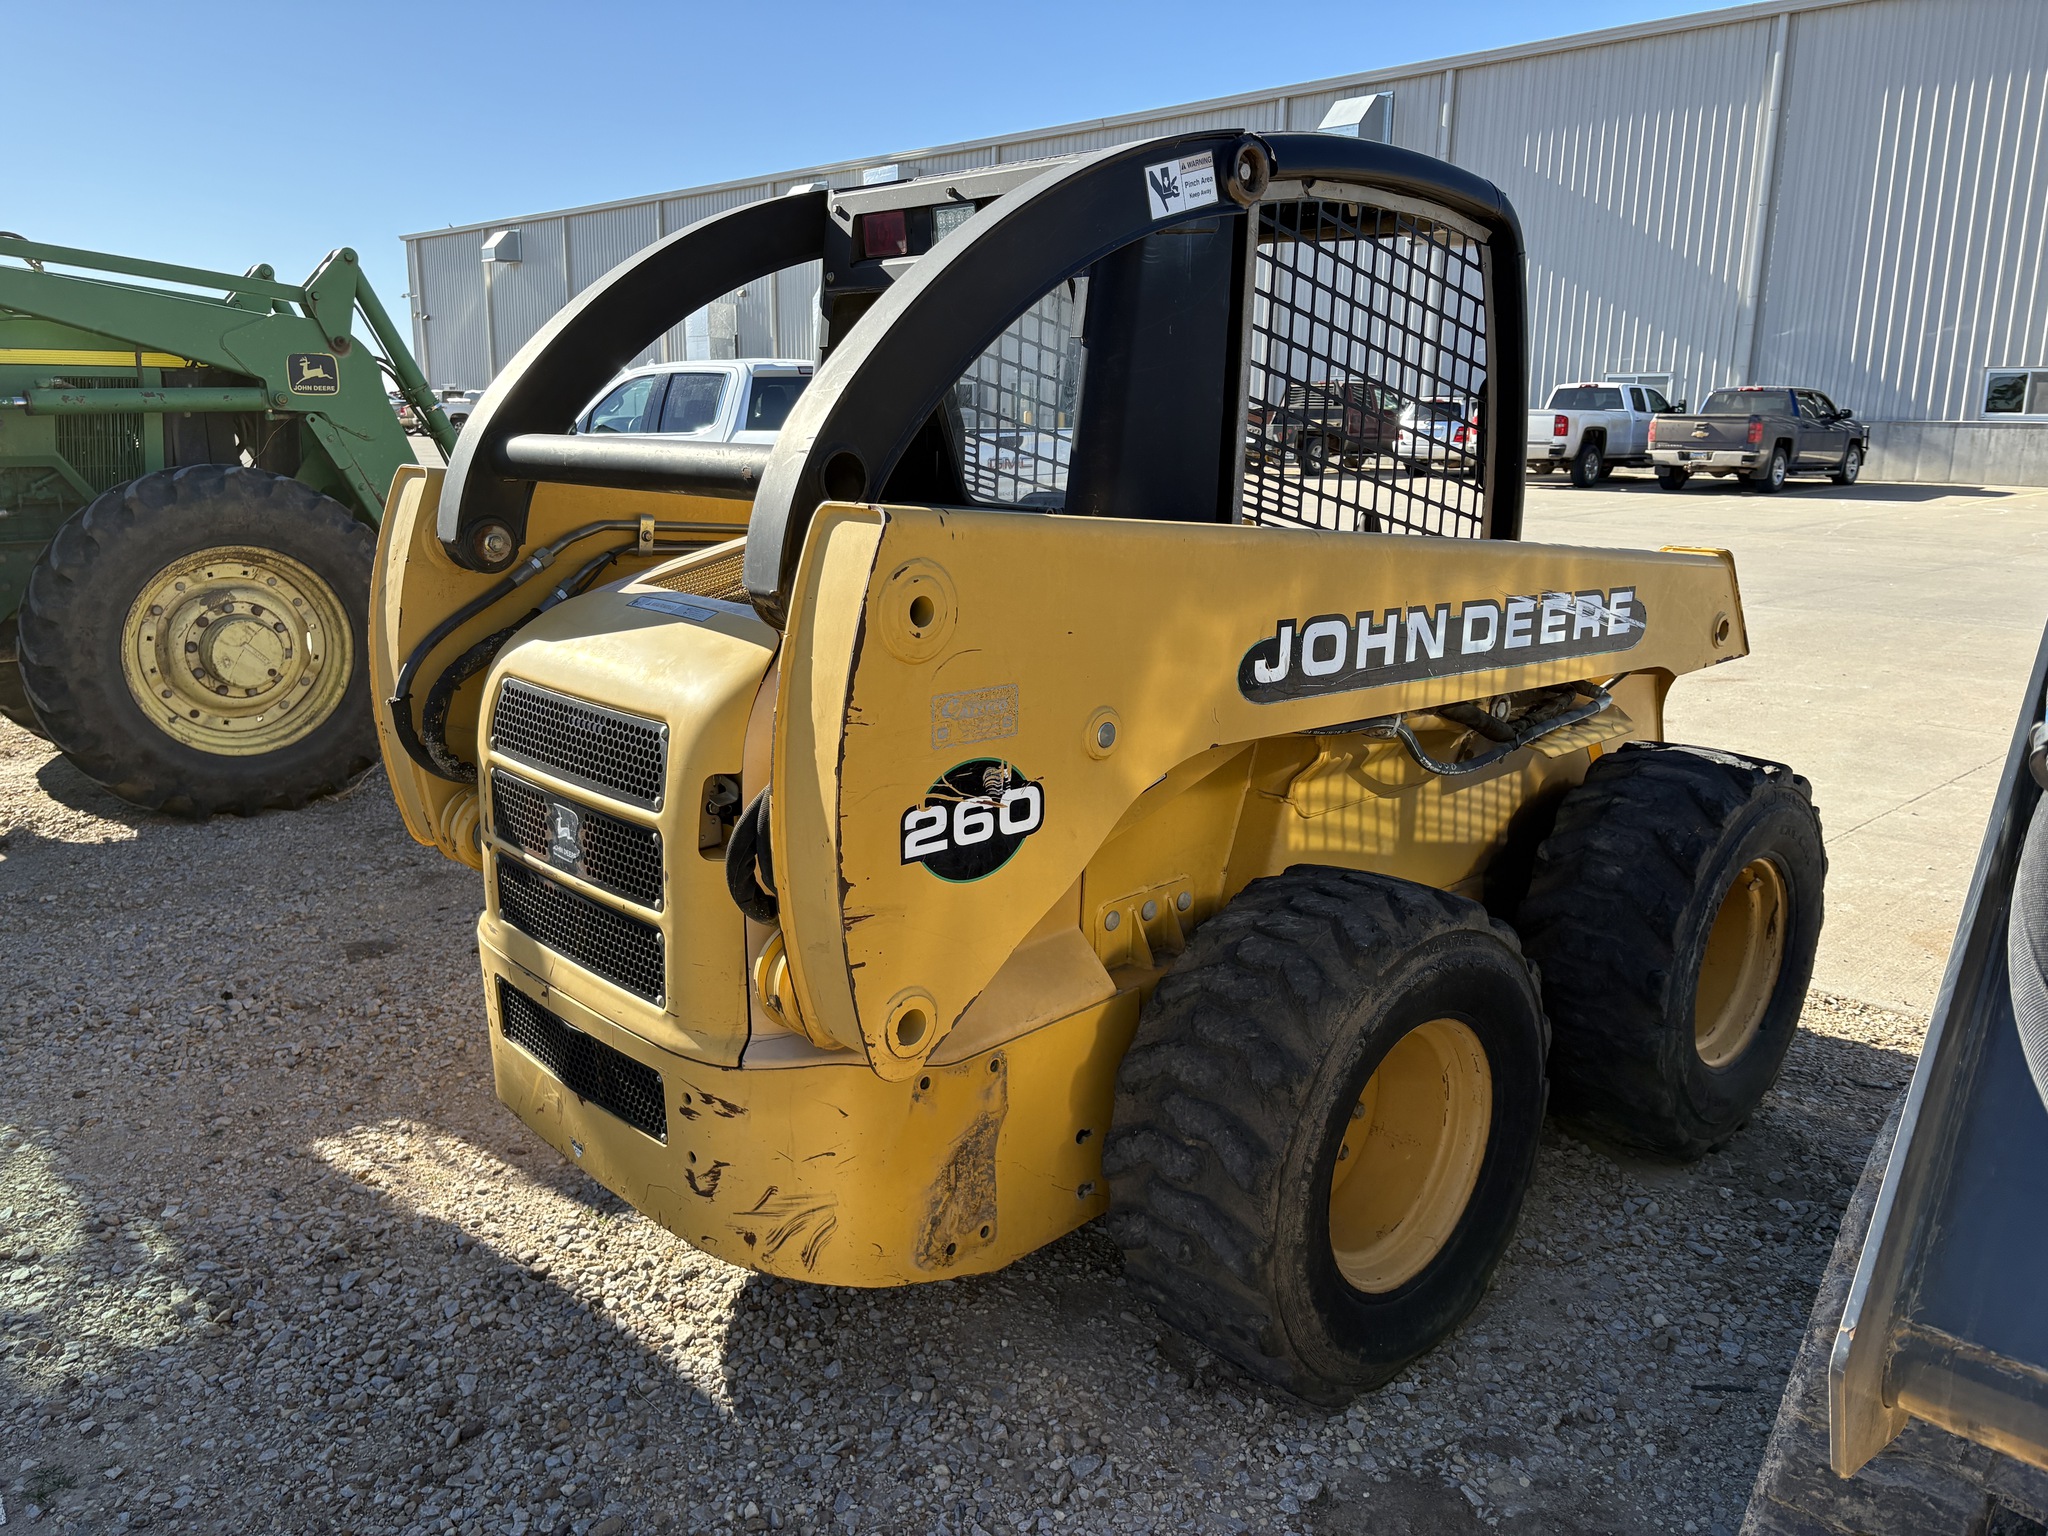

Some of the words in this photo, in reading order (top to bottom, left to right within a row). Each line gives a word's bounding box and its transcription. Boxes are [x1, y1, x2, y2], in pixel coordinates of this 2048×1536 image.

[1187, 156, 1212, 168] WARNING
[1185, 179, 1200, 188] Pinch
[1201, 176, 1213, 184] Area
[1189, 191, 1200, 199] Keep
[1253, 608, 1448, 684] JOHN
[1460, 590, 1634, 655] DEERE
[904, 785, 1041, 860] 260
